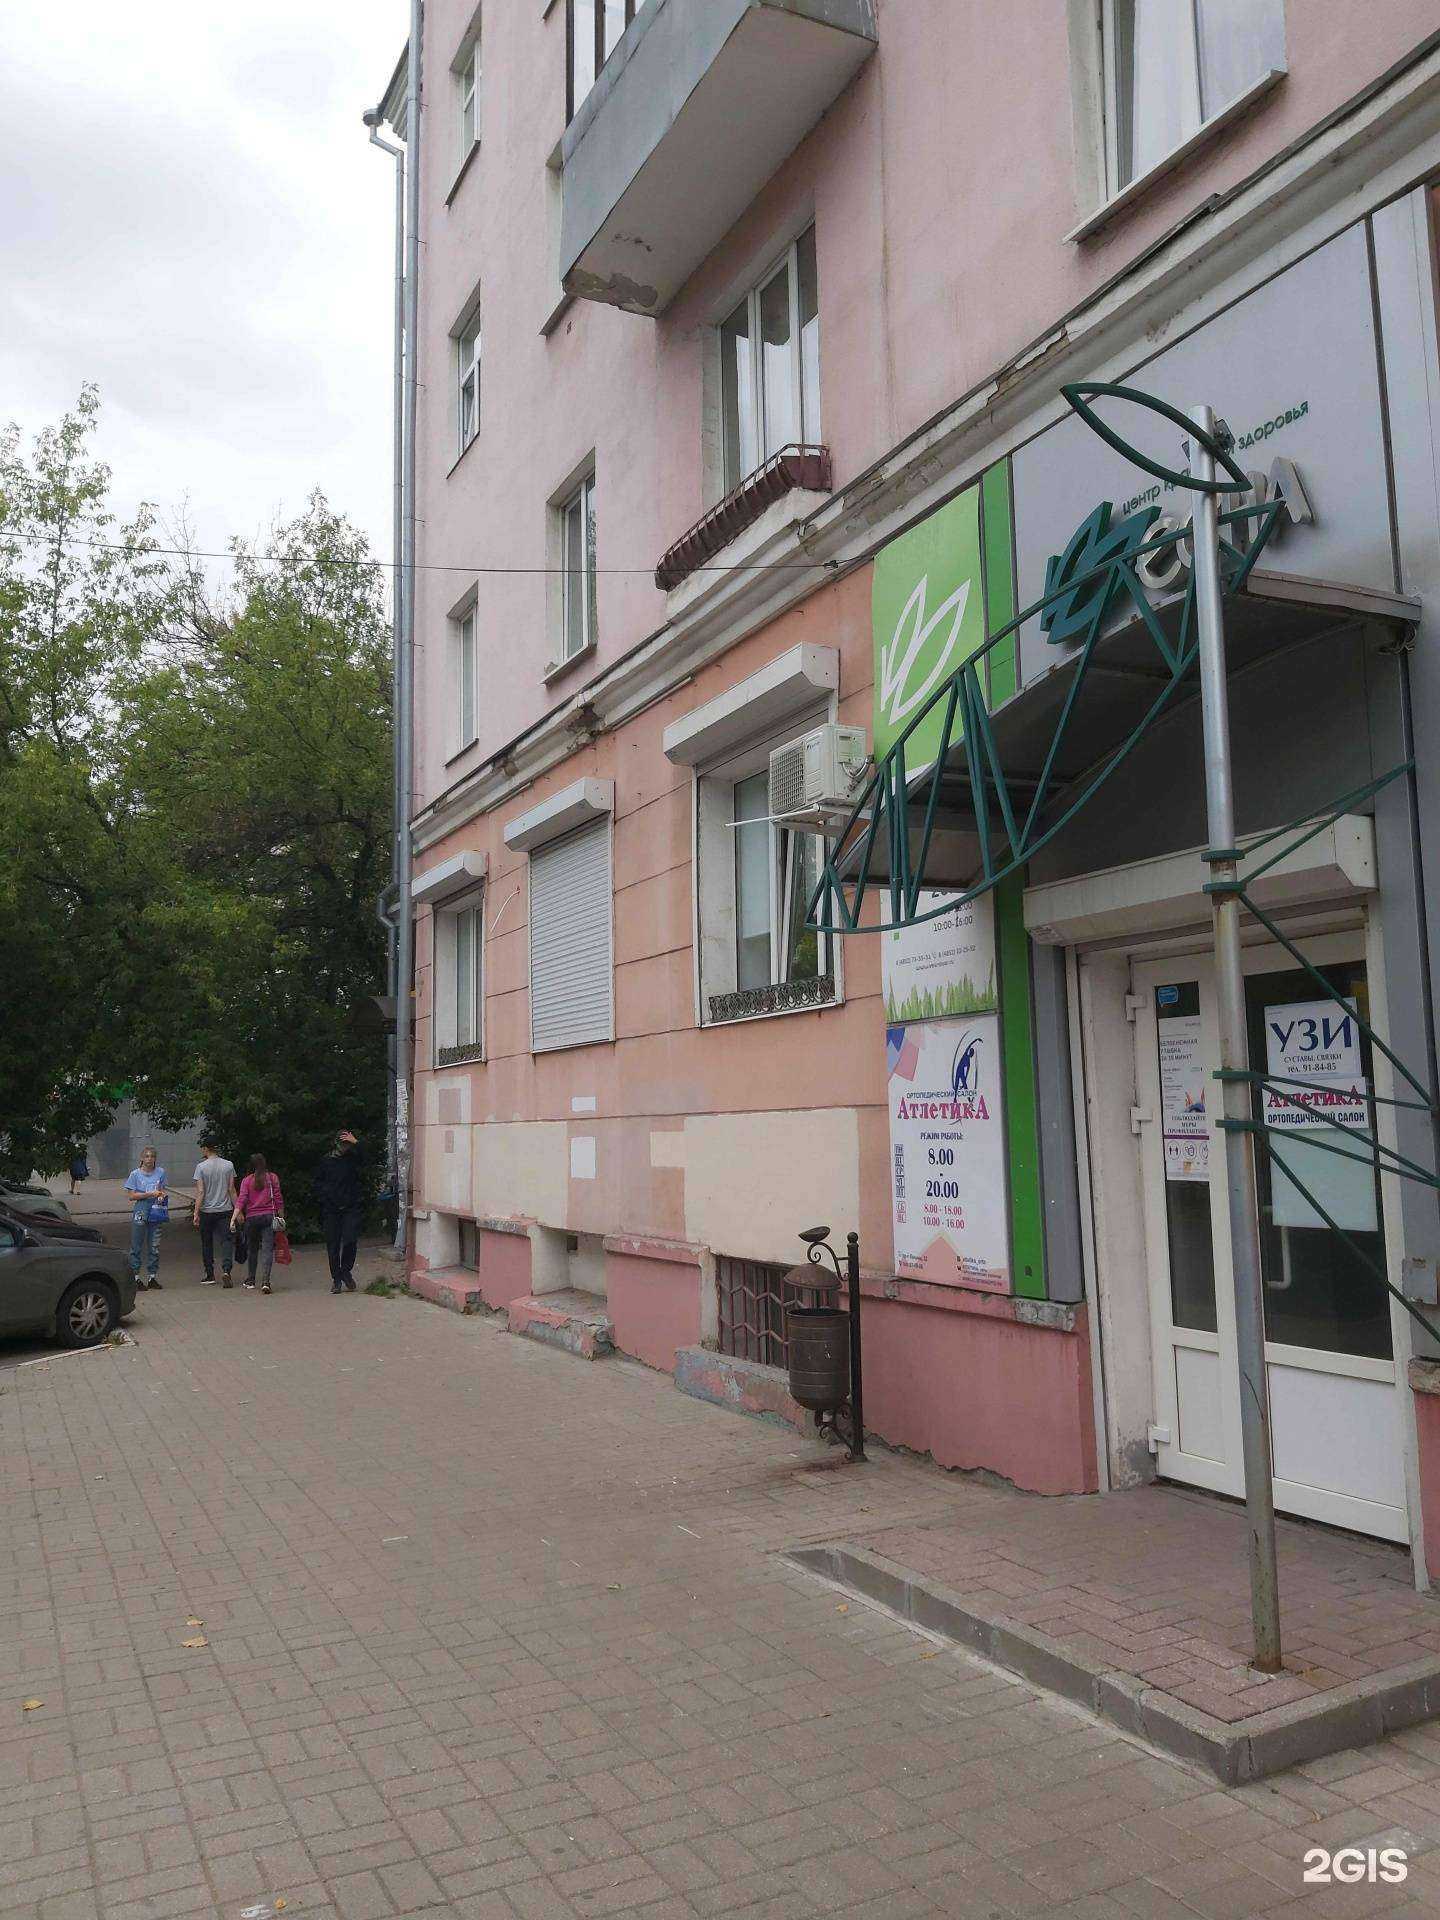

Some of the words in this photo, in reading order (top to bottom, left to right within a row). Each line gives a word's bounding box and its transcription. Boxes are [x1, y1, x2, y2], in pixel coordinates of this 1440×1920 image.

[1238, 400, 1309, 450] здоровья
[1123, 485, 1160, 515] центр
[1269, 1015, 1352, 1053] УЗИ
[1316, 1053, 1342, 1062] СВЯЗКИ
[906, 1090, 955, 1099] ОРТОПЕДИЧЕСКИЙ
[1338, 1112, 1365, 1122] САЛОН
[920, 1132, 940, 1141] РЕЖИМ
[928, 1148, 954, 1166] 8.00
[925, 1180, 959, 1199] 20.00
[923, 1203, 938, 1214] 8.00
[922, 1217, 941, 1227] 10.00
